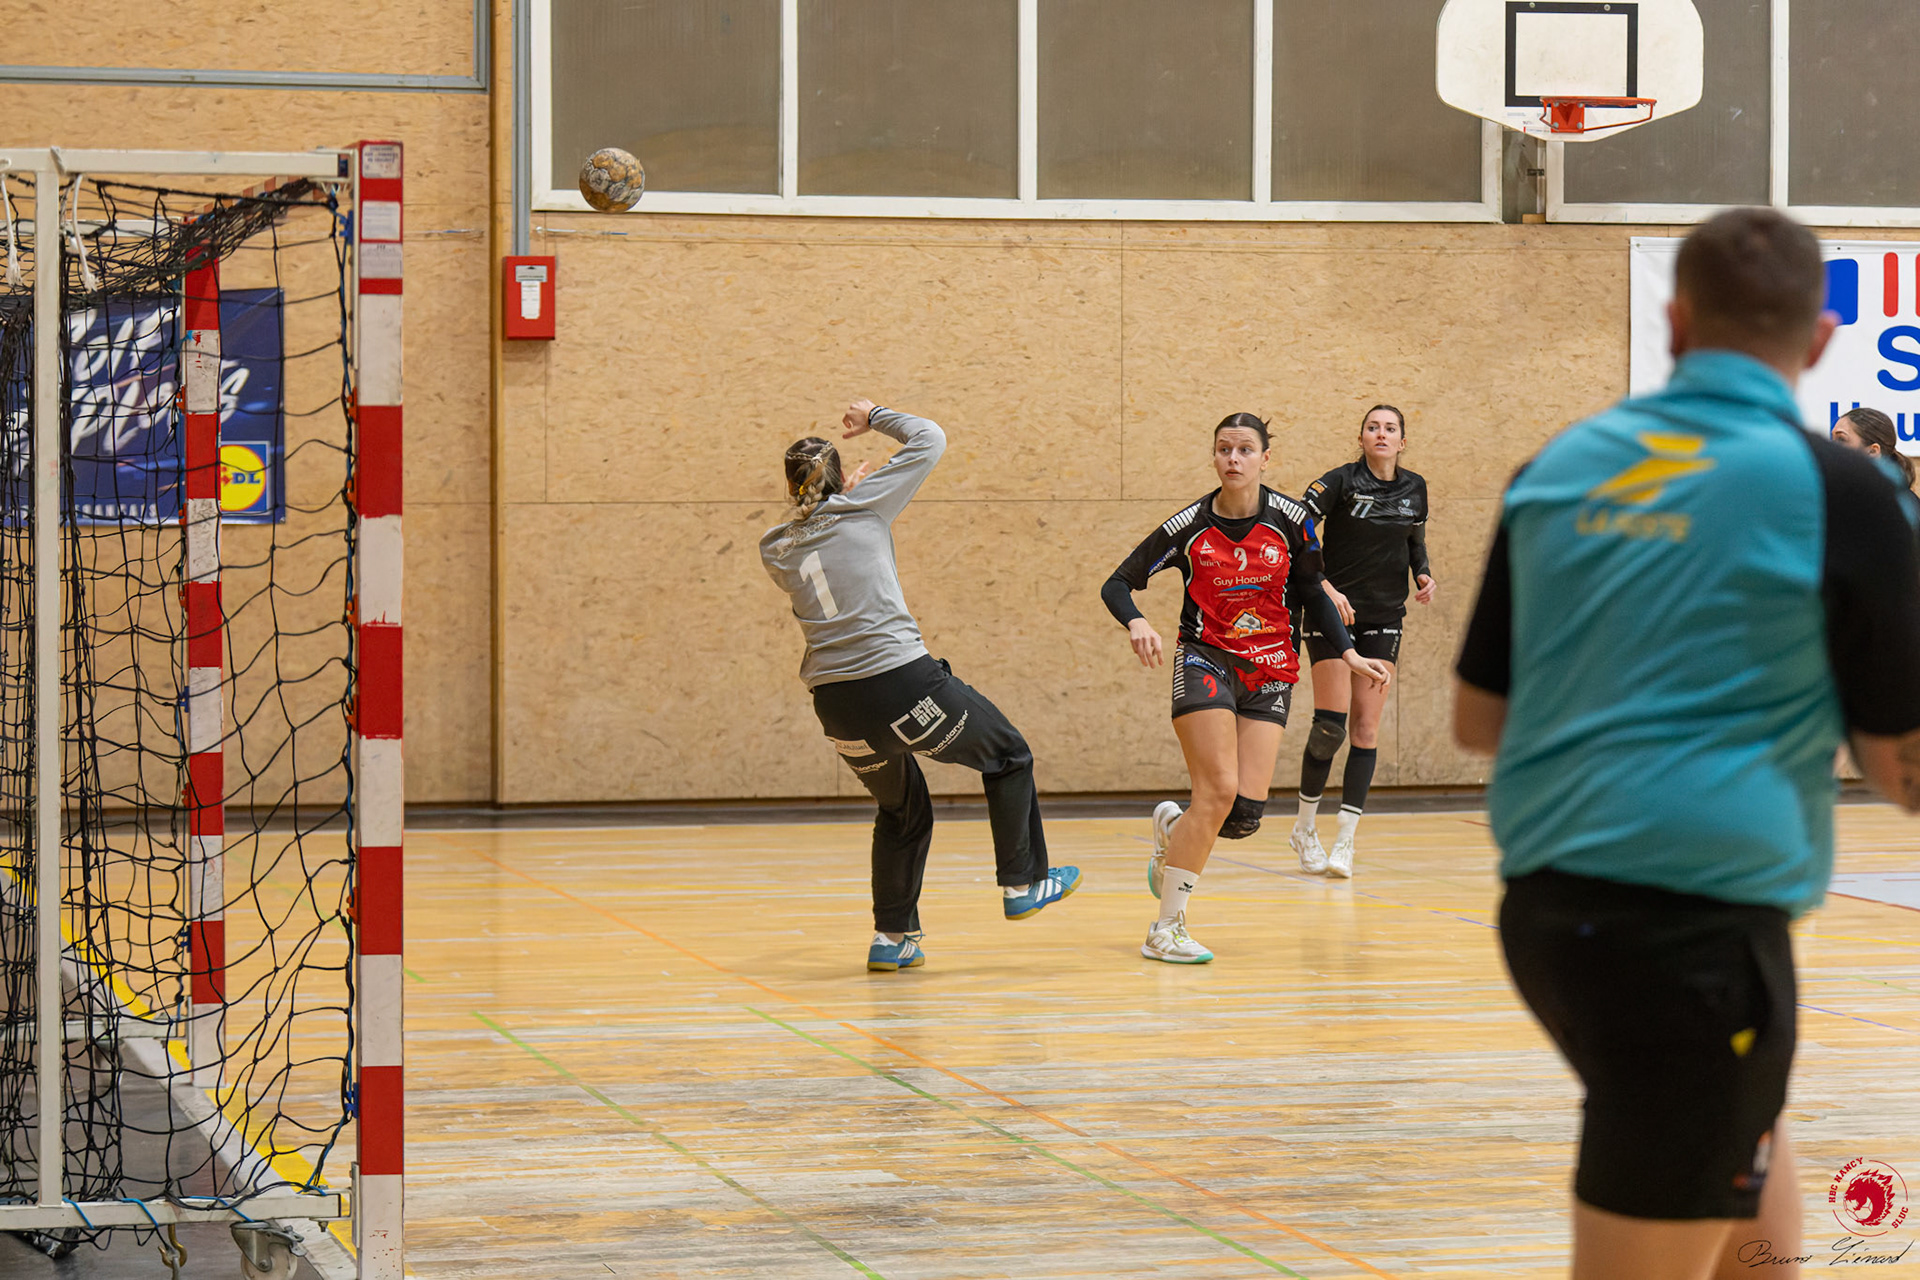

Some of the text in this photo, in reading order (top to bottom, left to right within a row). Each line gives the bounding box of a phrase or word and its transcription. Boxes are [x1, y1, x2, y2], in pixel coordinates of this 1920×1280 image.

[1350, 500, 1375, 519] 77
[799, 550, 839, 620] 1
[1213, 573, 1273, 587] Guy Hoquet
[916, 702, 944, 728] city
[930, 709, 969, 753] boulanger
